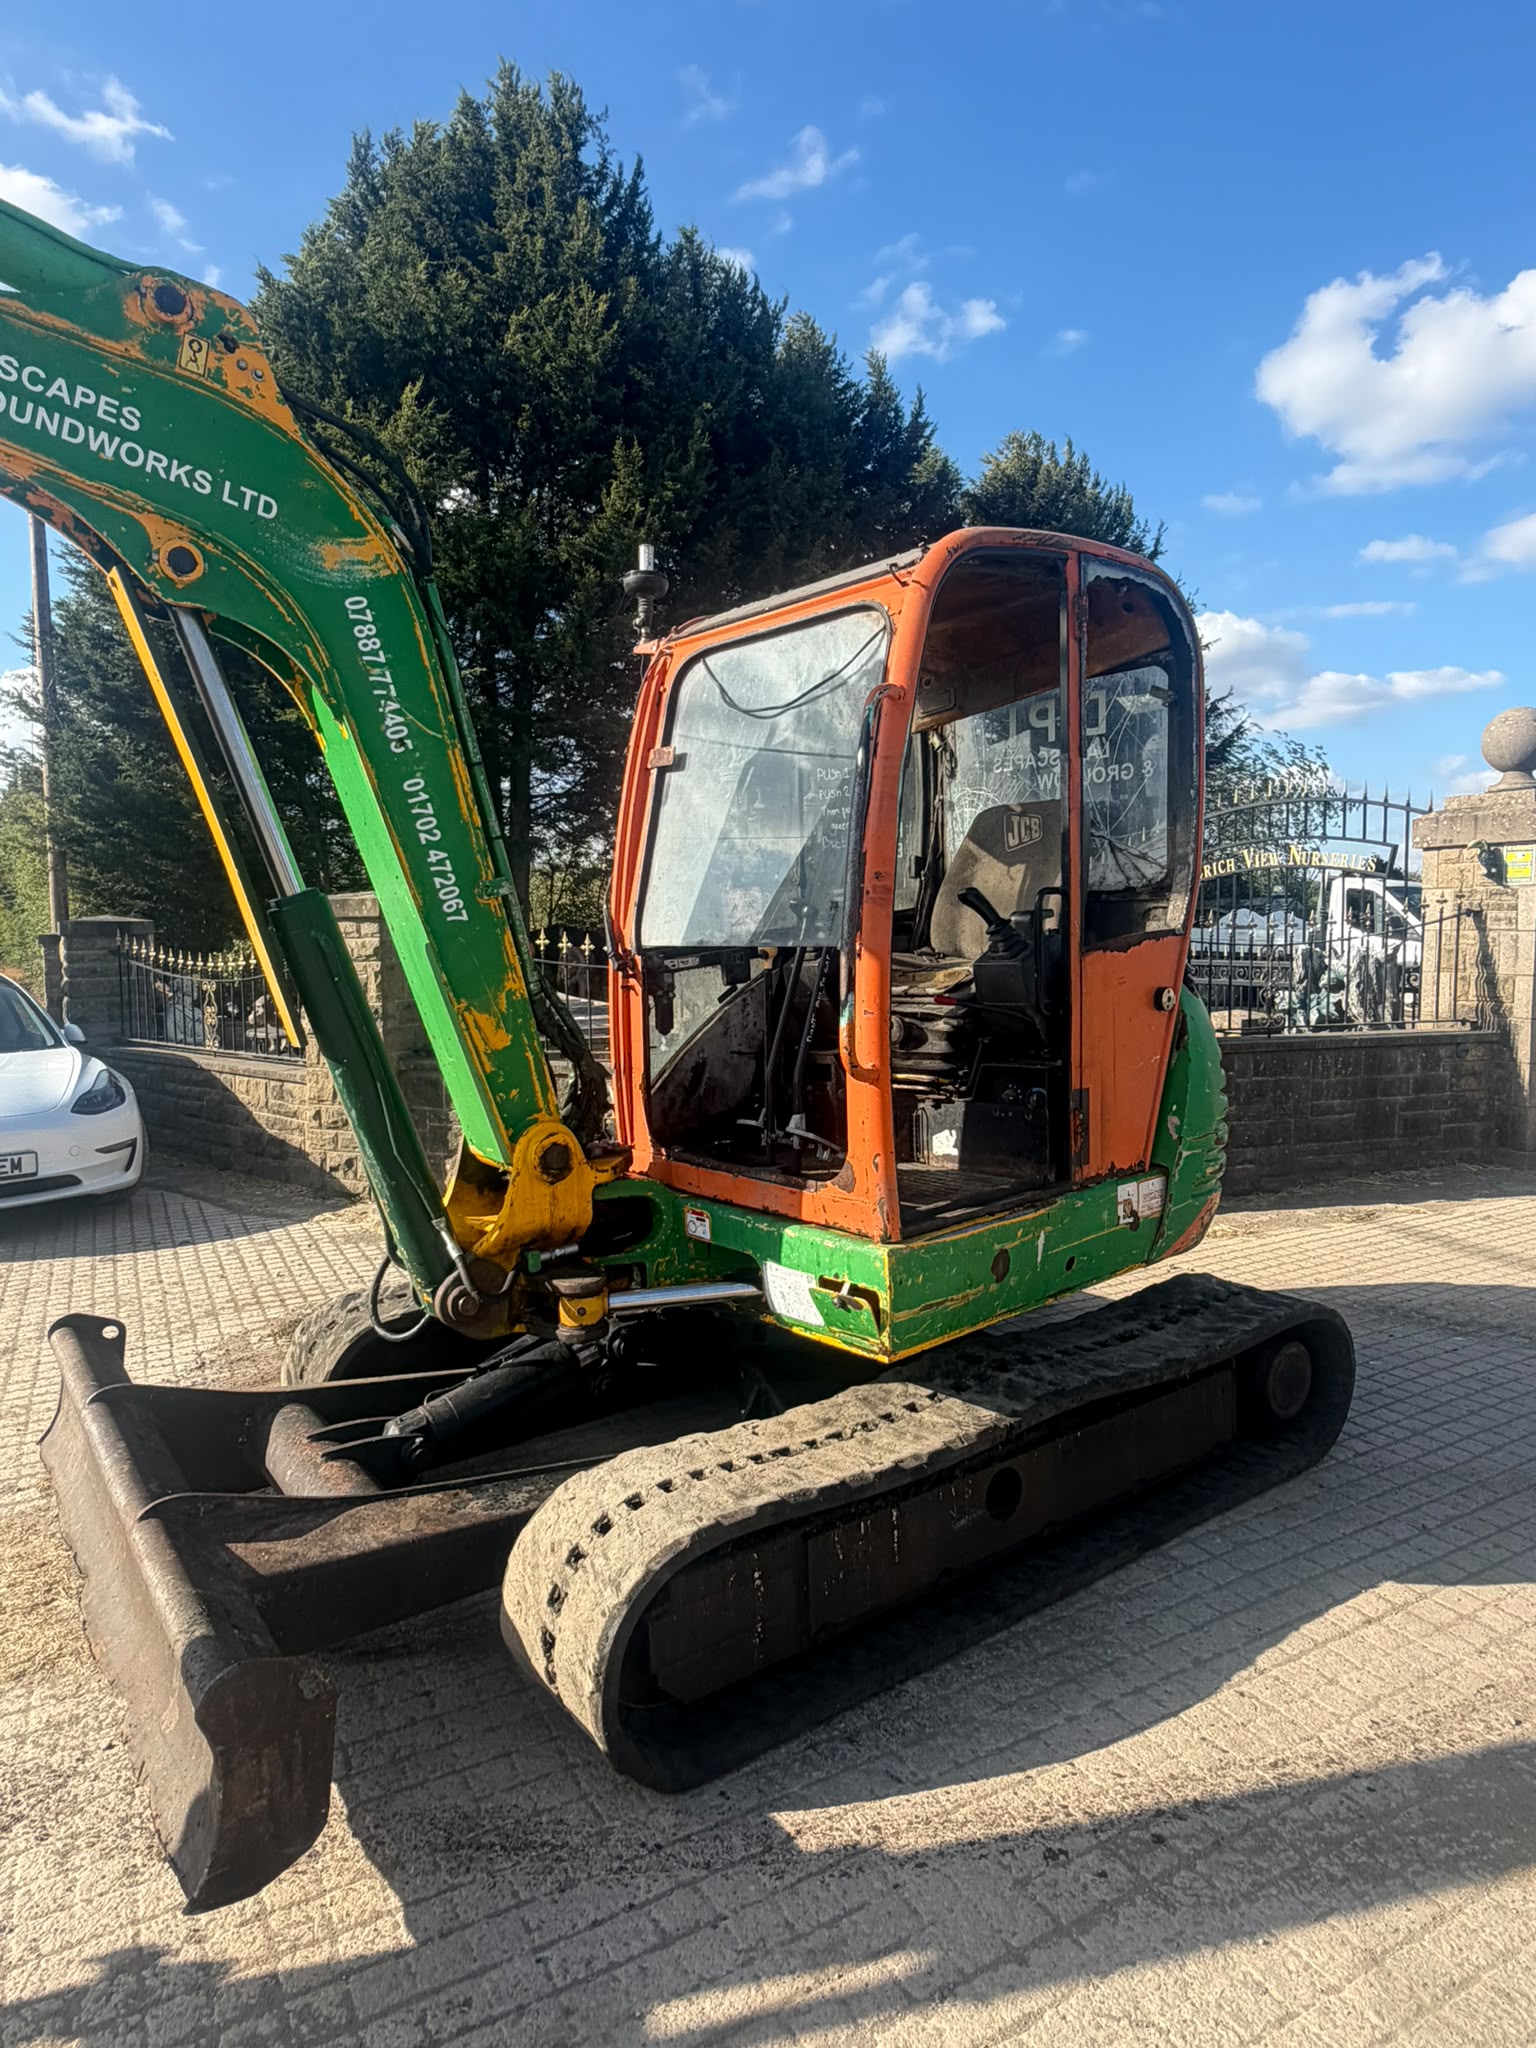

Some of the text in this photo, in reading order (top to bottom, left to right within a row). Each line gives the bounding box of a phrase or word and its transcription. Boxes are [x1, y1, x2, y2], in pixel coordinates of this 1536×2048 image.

[0, 391, 279, 520] UNDWORKS LTD
[403, 778, 469, 922] 01702 472067
[1007, 815, 1040, 847] JCB
[1200, 858, 1235, 879] RICH
[1288, 844, 1377, 873] NURSERIES
